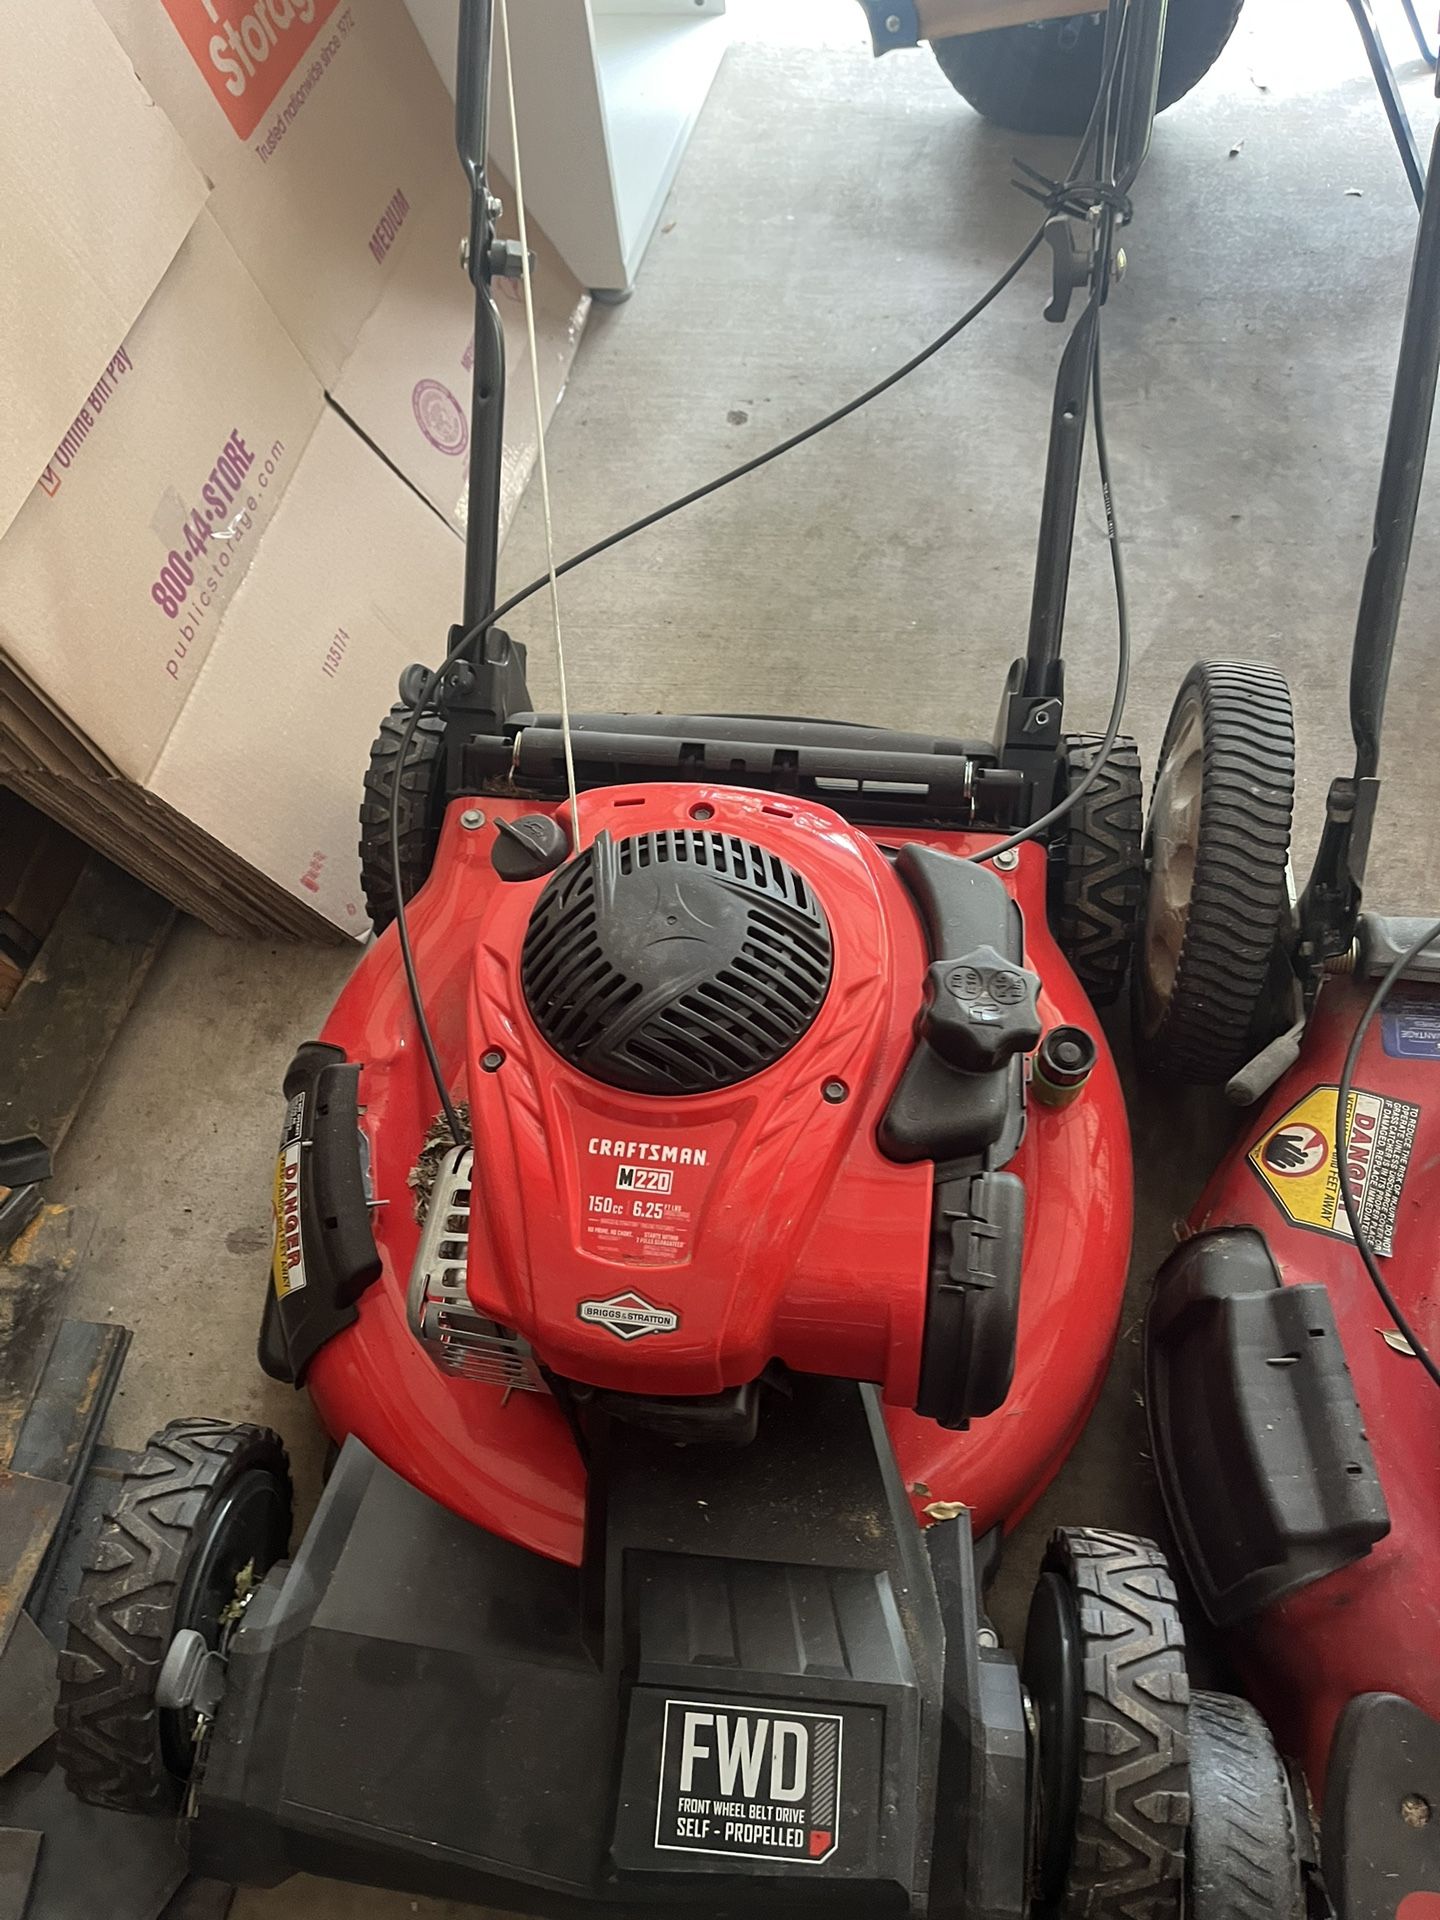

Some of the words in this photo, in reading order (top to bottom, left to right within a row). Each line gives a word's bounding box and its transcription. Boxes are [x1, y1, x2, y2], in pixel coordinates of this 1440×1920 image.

[255, 113, 287, 164] Trusted
[283, 61, 324, 124] nationwide
[320, 35, 342, 67] since
[368, 188, 410, 265] MEDIUM
[106, 345, 133, 385] Pay
[1385, 1099, 1392, 1107] IF
[1390, 1102, 1401, 1124] GRASS
[1409, 1108, 1418, 1117] TO
[1397, 1105, 1409, 1138] OPERATE
[1403, 1118, 1416, 1147] REDUCE
[588, 1138, 707, 1166] CRAFTSMAN
[1384, 1125, 1396, 1158] CATCHER
[1390, 1139, 1402, 1169] UNLESS
[1370, 1149, 1383, 1185] REPLACE
[1400, 1149, 1409, 1164] THE
[618, 1168, 670, 1191] M220
[1326, 1170, 1340, 1193] FEET
[1377, 1176, 1386, 1188] ITS
[1396, 1164, 1405, 1183] RISK
[1382, 1170, 1395, 1212] DISCHARGE
[1393, 1184, 1401, 1195] OF
[284, 1163, 301, 1269] DANGER
[633, 1200, 664, 1219] 6.25
[1321, 1193, 1336, 1222] AWAY
[1372, 1189, 1383, 1219] PROPER
[1376, 1213, 1386, 1238] COVER
[1384, 1224, 1392, 1236] DO
[1374, 1239, 1382, 1250] OR
[1382, 1236, 1390, 1252] NOT
[680, 1712, 808, 1801] FWD
[678, 1797, 711, 1814] FRONT
[714, 1801, 746, 1818] WHEEL
[749, 1804, 774, 1821] BELT
[776, 1807, 805, 1823] DRIVE
[677, 1818, 710, 1838] SELF
[725, 1822, 804, 1847] PROPELLED
